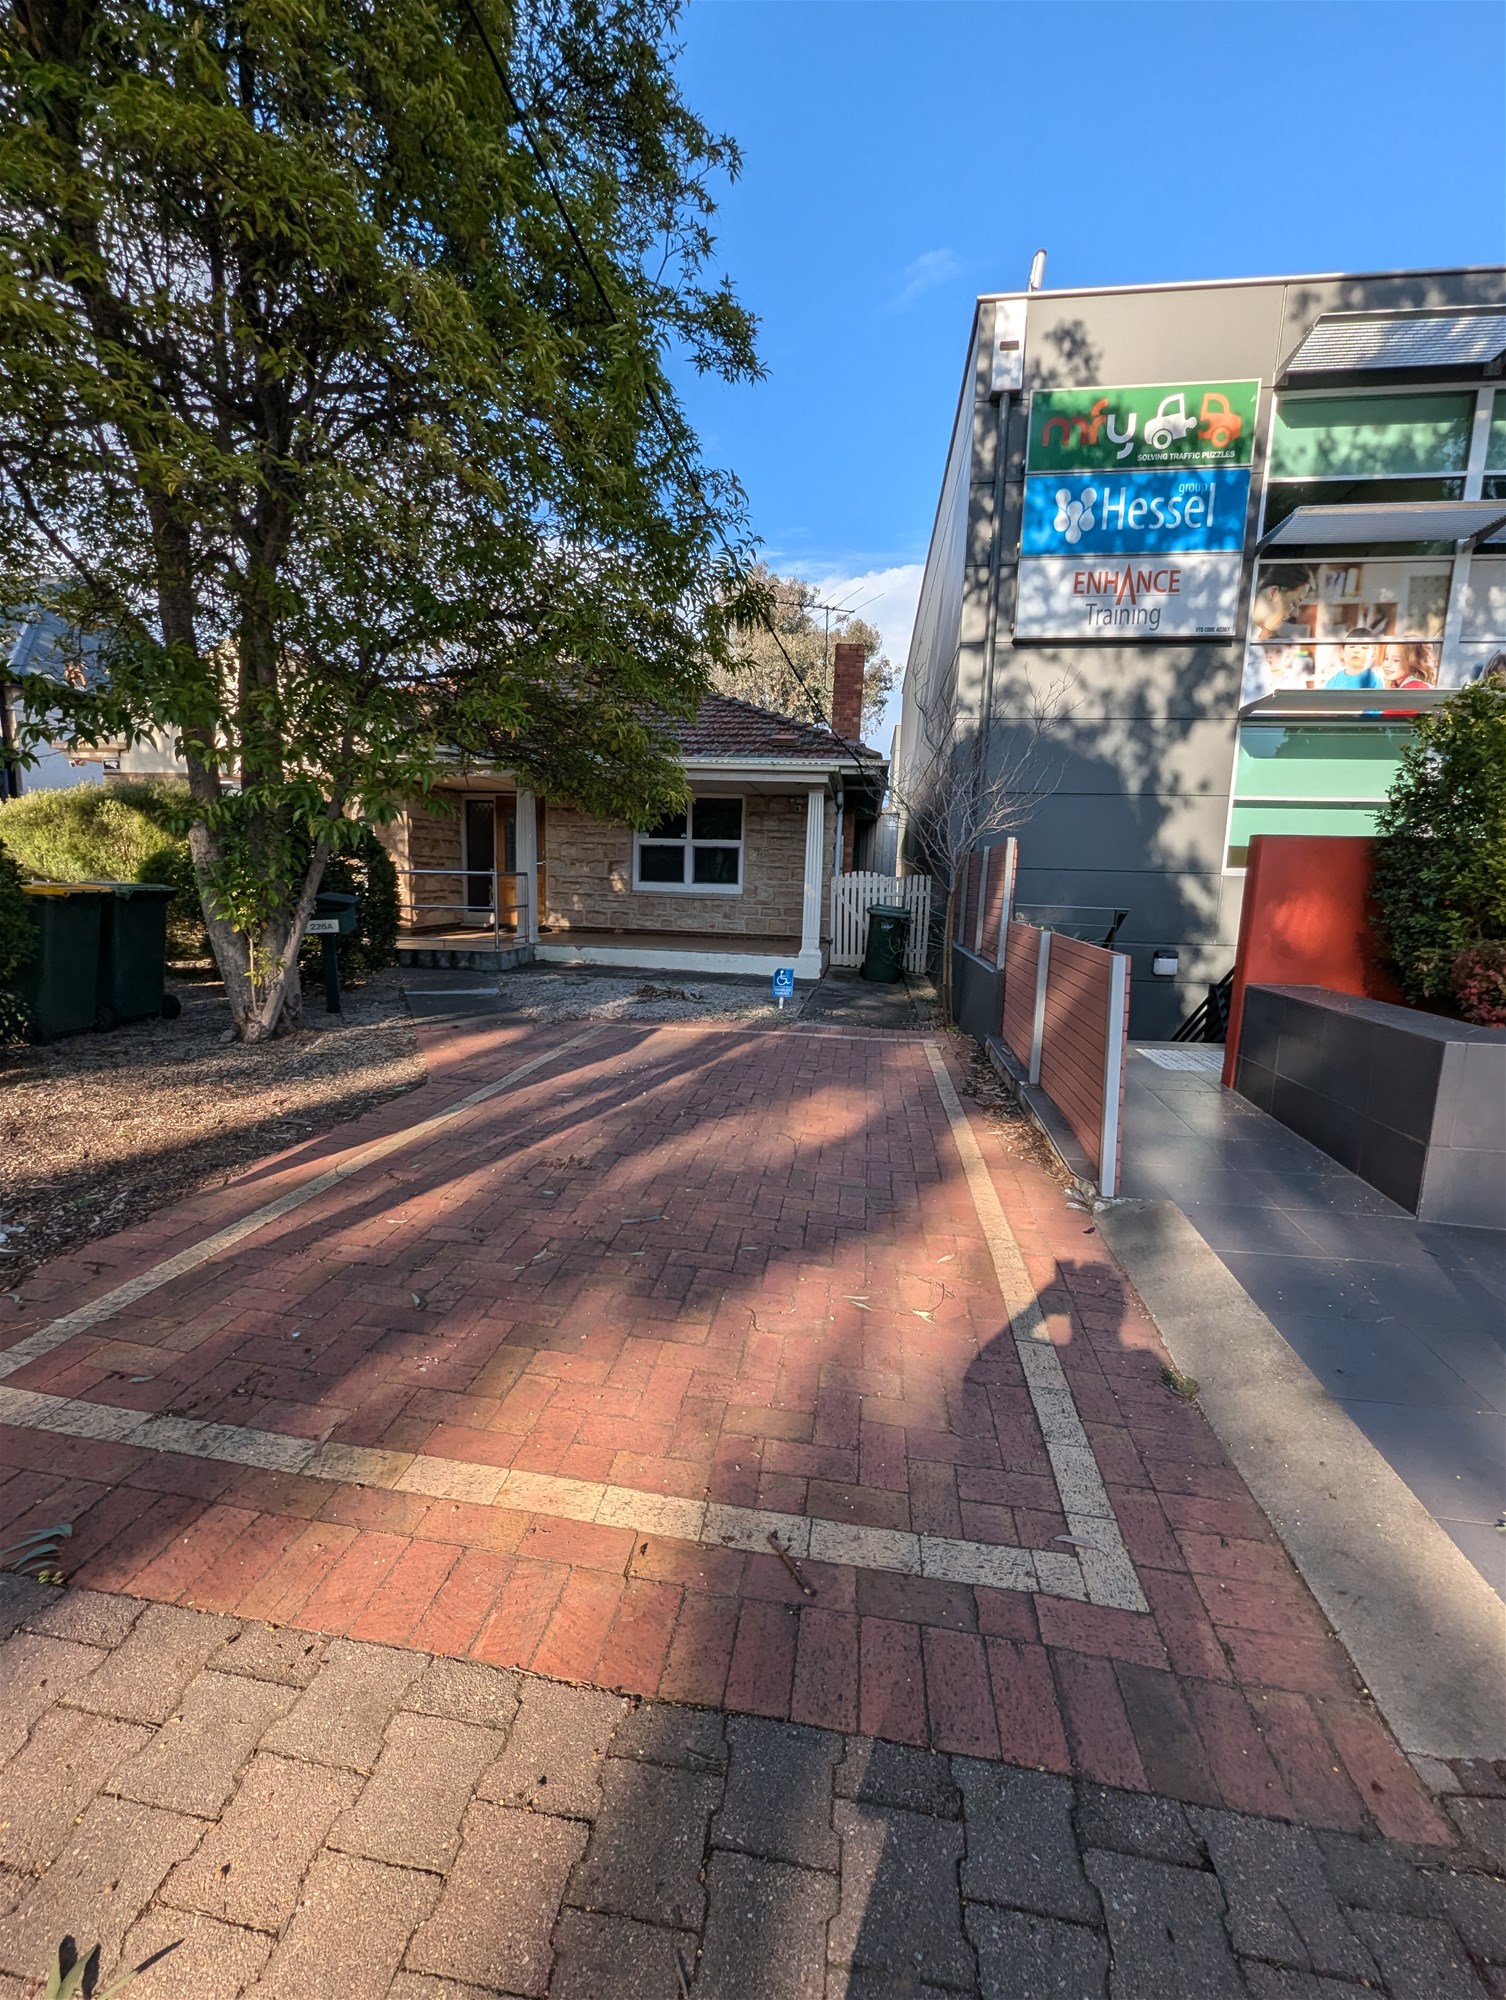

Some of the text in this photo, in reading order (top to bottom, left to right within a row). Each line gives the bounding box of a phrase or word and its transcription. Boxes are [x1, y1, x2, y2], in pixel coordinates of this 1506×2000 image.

[1041, 398, 1137, 460] mfy
[1137, 450, 1236, 462] SOLVING TRAFFIC PUZZLES
[1101, 482, 1216, 531] Hessel
[1178, 483, 1208, 496] group
[1073, 563, 1181, 606] ENHANCE
[1085, 603, 1161, 631] Training
